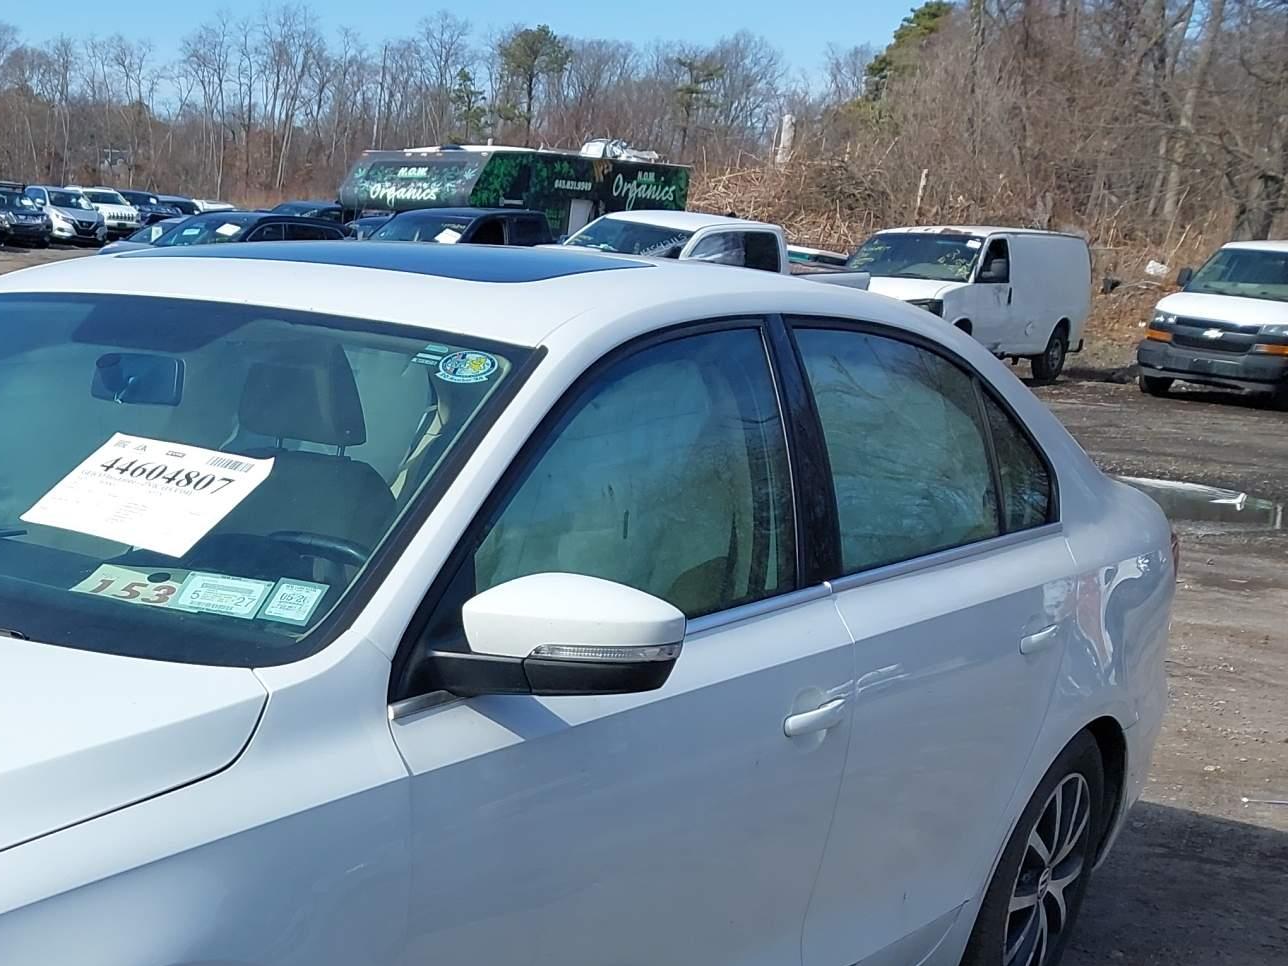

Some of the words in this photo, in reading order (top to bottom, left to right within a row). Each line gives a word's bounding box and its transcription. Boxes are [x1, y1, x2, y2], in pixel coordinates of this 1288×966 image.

[370, 182, 439, 206] Organics
[612, 173, 676, 209] Organics
[100, 457, 235, 496] 44604807
[89, 579, 177, 604] 153
[190, 590, 202, 600] 5
[234, 597, 257, 608] 27
